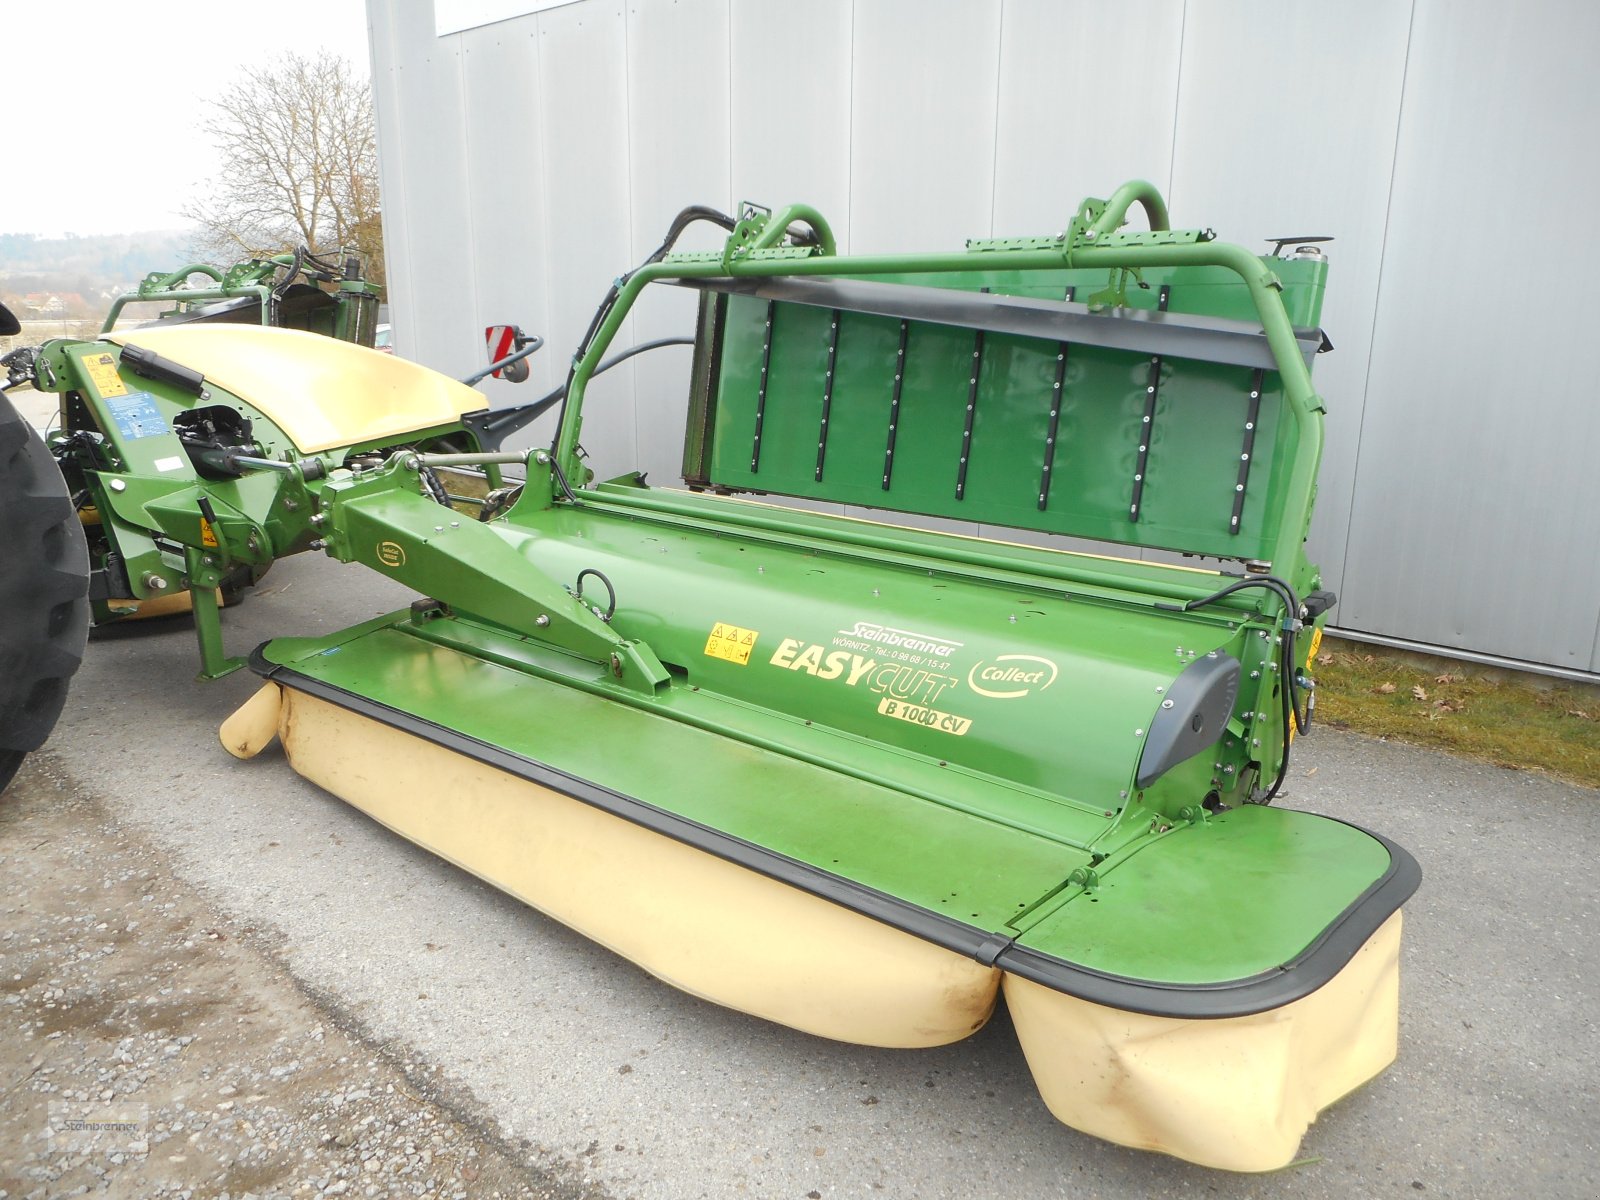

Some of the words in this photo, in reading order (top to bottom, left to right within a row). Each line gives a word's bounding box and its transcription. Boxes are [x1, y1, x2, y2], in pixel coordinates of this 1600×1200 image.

[838, 621, 957, 657] Steinbrenner
[897, 652, 909, 661] 98
[909, 654, 921, 664] 68
[927, 659, 938, 668] 15
[938, 661, 951, 671] 47
[981, 666, 1044, 683] Collect
[885, 701, 897, 715] B
[940, 716, 965, 732] CV
